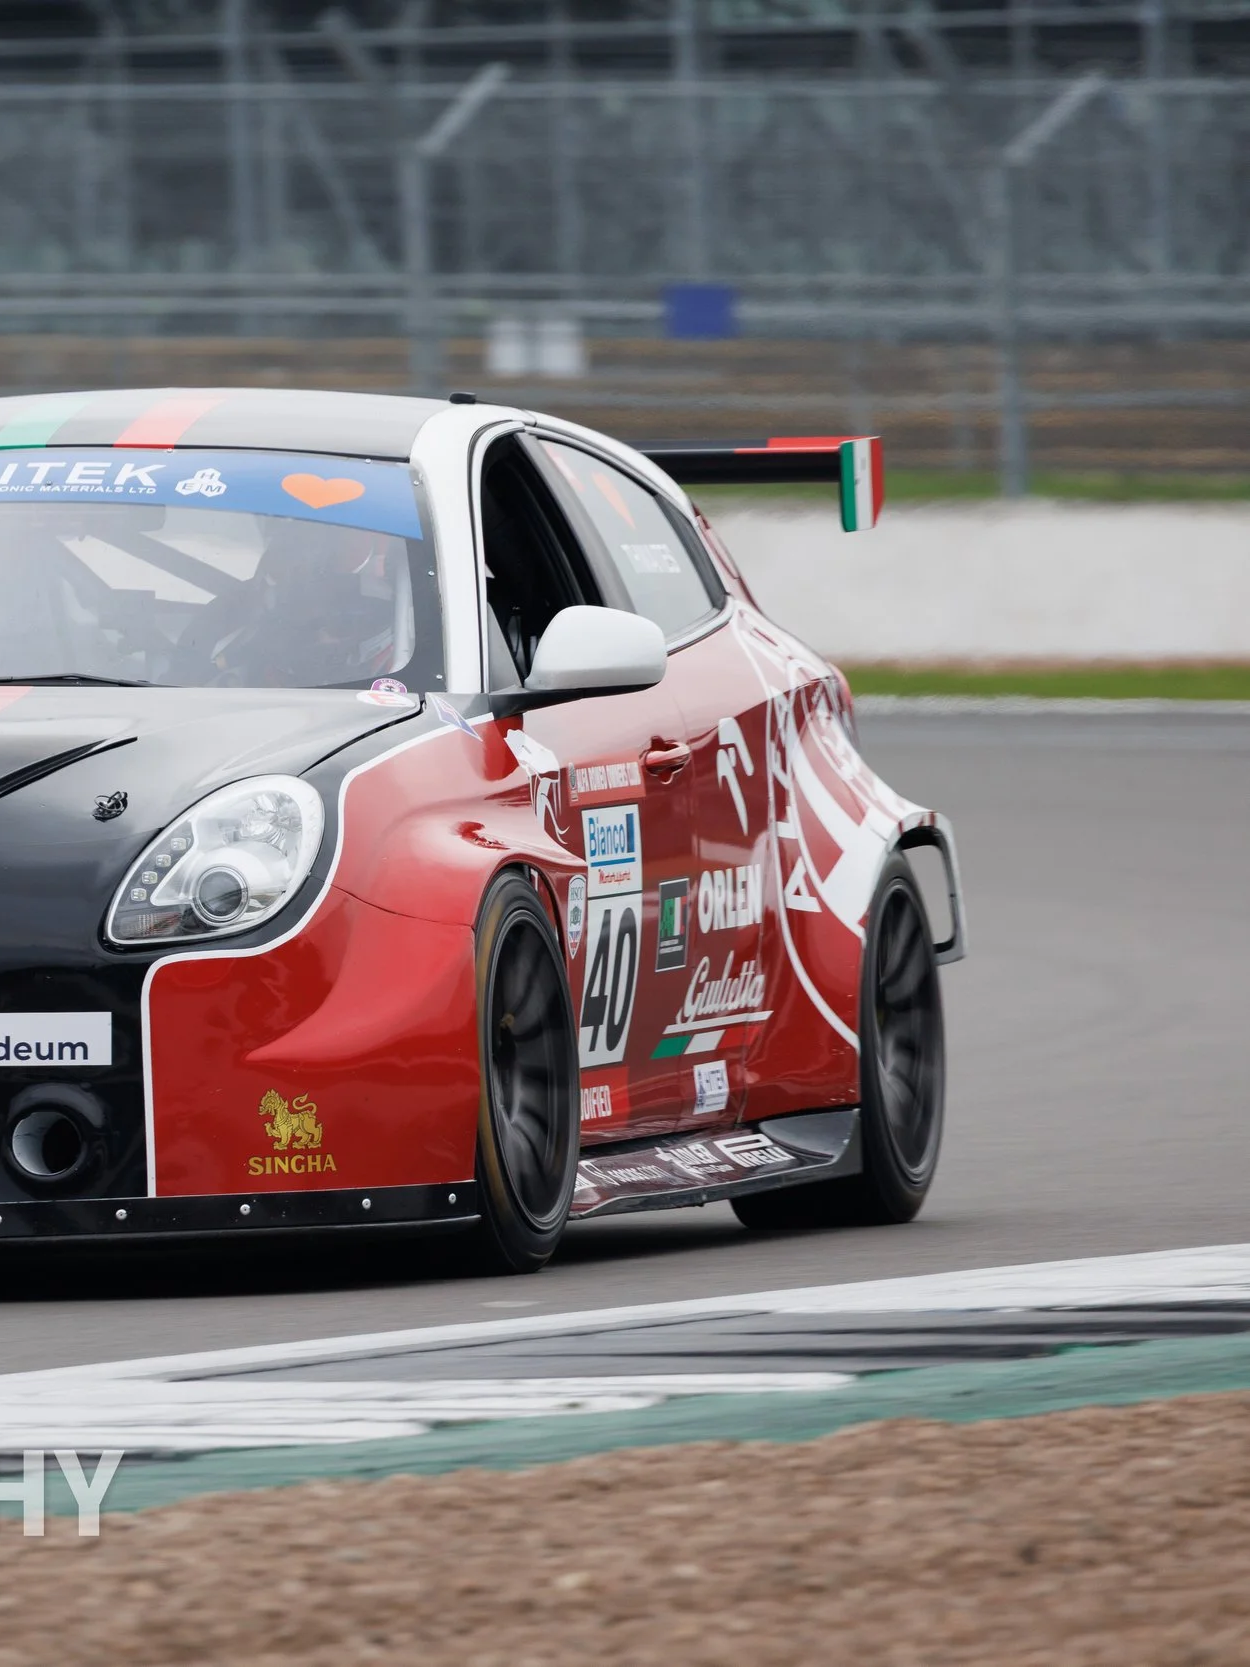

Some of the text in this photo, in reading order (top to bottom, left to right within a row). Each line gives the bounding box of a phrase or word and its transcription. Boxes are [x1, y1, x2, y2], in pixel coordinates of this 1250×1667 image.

[47, 484, 124, 495] MATERIALS
[130, 485, 156, 494] LTD
[588, 817, 625, 856] Bianco
[698, 864, 763, 934] ORLEN
[580, 907, 637, 1053] 40
[248, 1154, 337, 1176] SINGHA
[714, 1133, 796, 1168] PIRELLI
